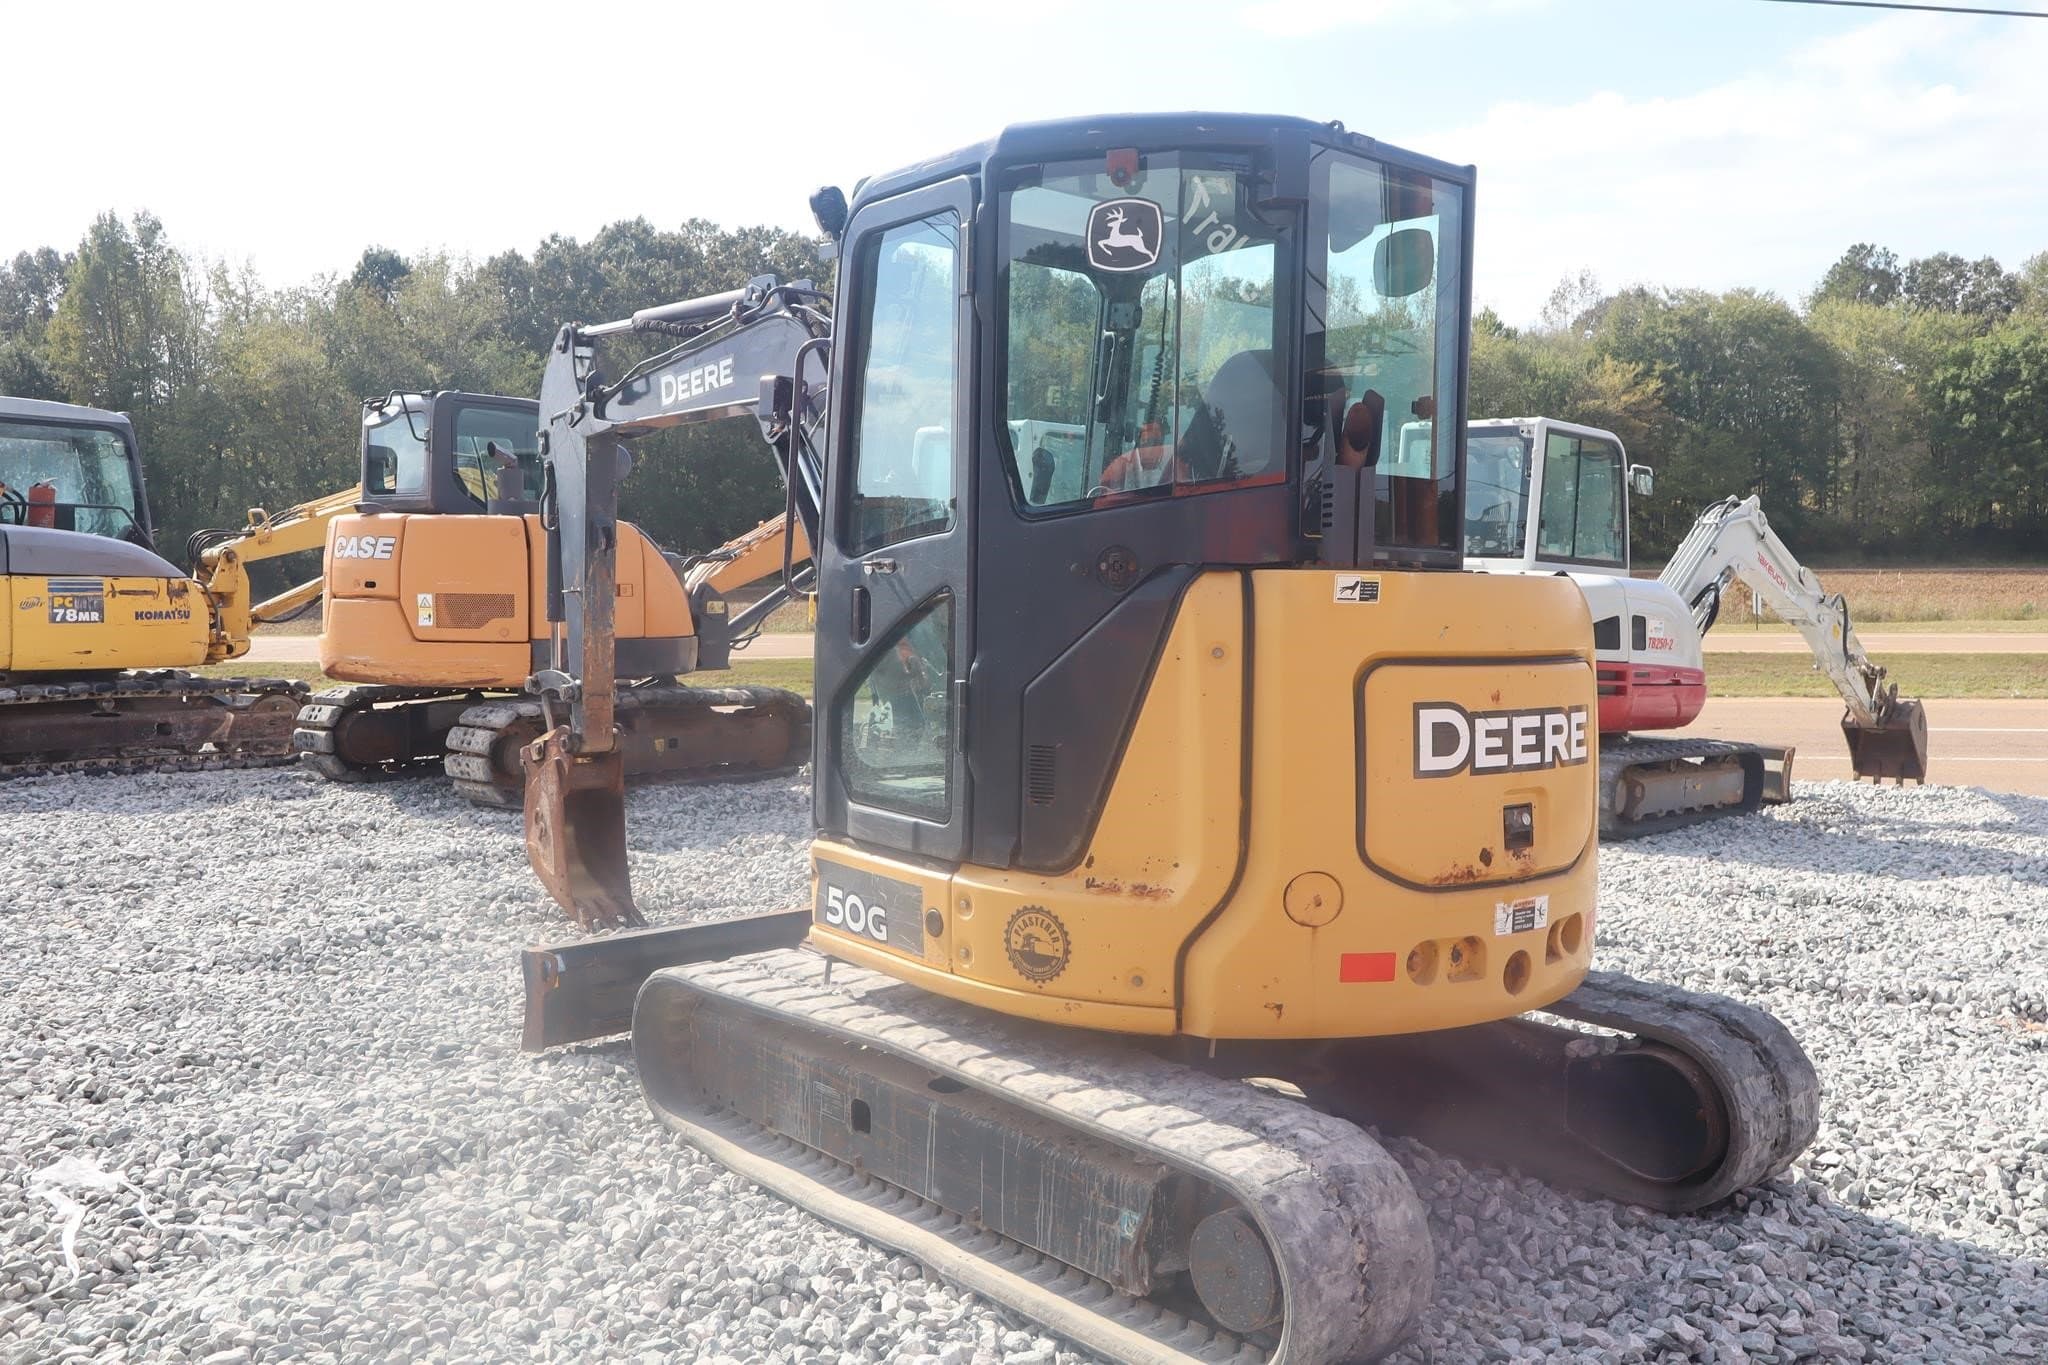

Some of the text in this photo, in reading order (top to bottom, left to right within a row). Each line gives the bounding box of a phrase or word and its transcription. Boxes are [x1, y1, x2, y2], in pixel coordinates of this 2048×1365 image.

[660, 357, 734, 407] DEERE
[334, 535, 396, 560] CASE
[53, 597, 74, 609] PC
[53, 608, 101, 623] 78MR
[134, 608, 191, 621] KOMATSU
[1418, 706, 1589, 773] DEERE
[826, 885, 889, 942] 50G
[1013, 915, 1061, 945] PLASTERER
